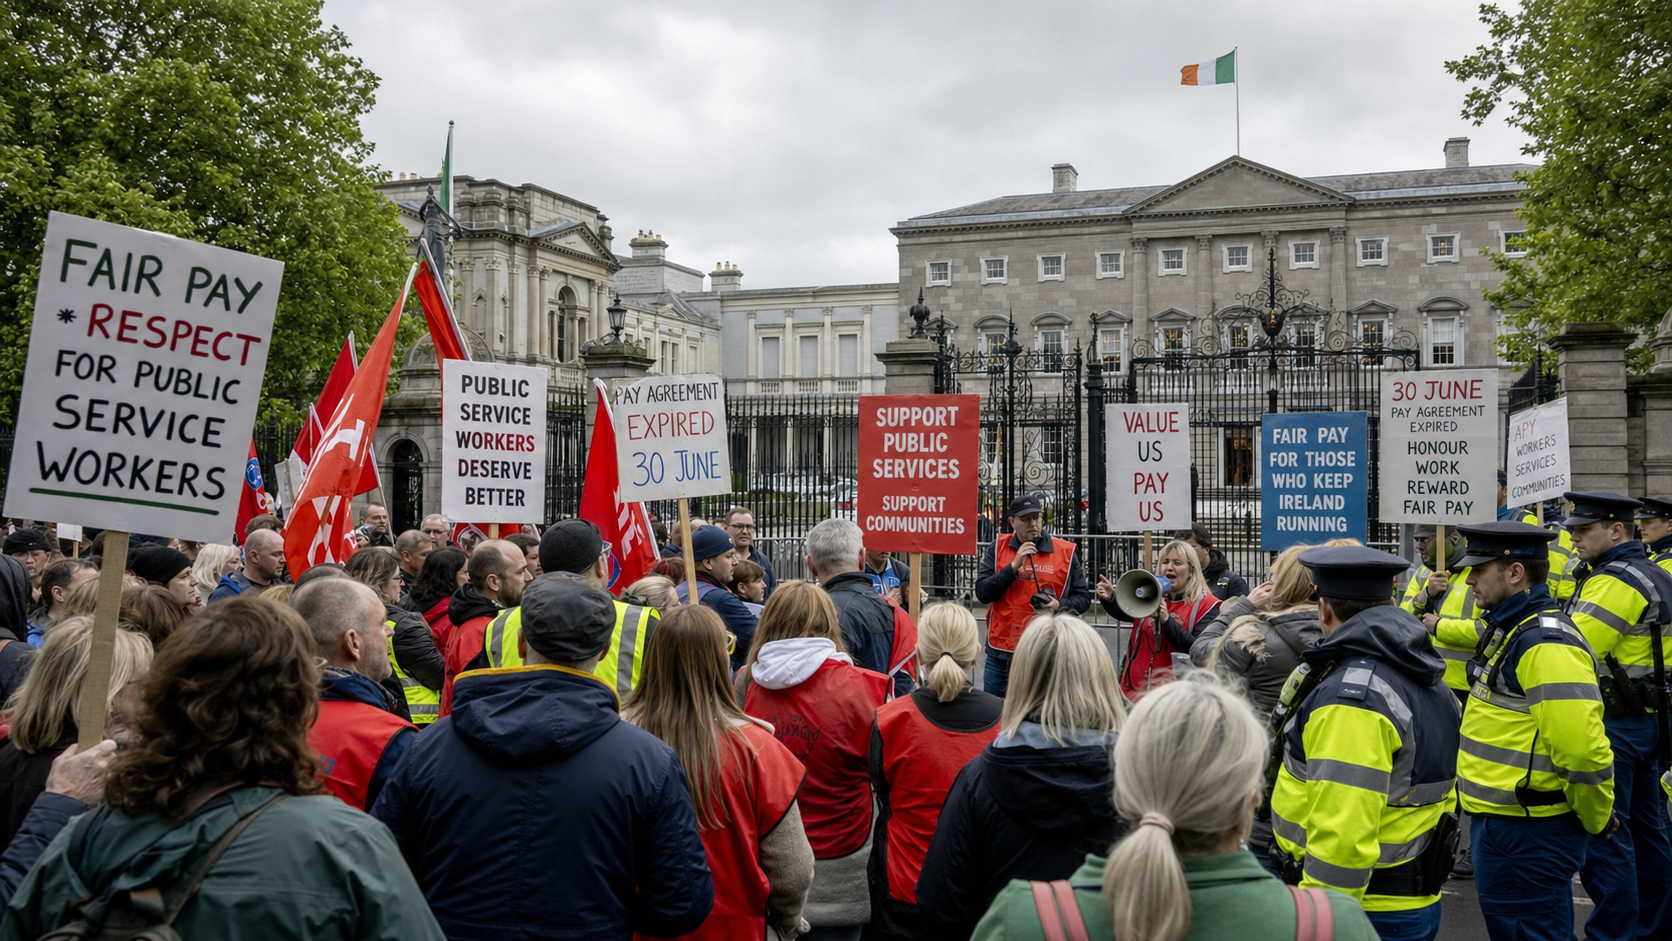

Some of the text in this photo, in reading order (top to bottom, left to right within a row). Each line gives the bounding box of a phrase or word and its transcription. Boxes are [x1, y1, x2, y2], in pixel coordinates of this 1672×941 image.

[60, 239, 263, 314] FAIR PAY
[87, 303, 262, 366] RESPECT
[55, 350, 240, 404] FOR PUBLIC
[462, 375, 529, 398] PUBLIC
[616, 382, 719, 405] PAY AGREEMENT
[1392, 380, 1483, 401] 30 JUNE
[53, 394, 226, 448] SERVICE
[460, 403, 531, 425] SERVICE
[876, 406, 958, 427] SUPPORT
[1391, 405, 1485, 418] PAY AGREEMENT
[628, 411, 714, 440] EXPIRED
[1123, 412, 1179, 433] VALUE
[1410, 421, 1457, 433] EXPIRED
[456, 431, 535, 452] WORKERS
[883, 432, 948, 453] PUBLIC
[1273, 427, 1349, 444] FAIR PAY
[1516, 434, 1556, 457] WORKERS
[1138, 441, 1162, 462] US
[1408, 441, 1468, 455] HONOUR
[458, 459, 531, 479] DESERVE
[633, 450, 721, 486] 30 JUNE
[873, 459, 960, 479] SERVICES
[1270, 451, 1356, 467] FOR THOSE
[1416, 461, 1460, 475] WORK
[1515, 454, 1556, 477] SERVICES
[37, 440, 226, 500] WORKERS
[1272, 473, 1353, 488] WHO KEEP
[1134, 472, 1169, 494] PAY
[1408, 480, 1469, 494] REWARD
[1512, 474, 1565, 499] COMMUNITIES
[465, 487, 525, 506] BETTER
[882, 496, 946, 512] SUPPORT
[1280, 495, 1345, 510] IRELAND
[1140, 501, 1163, 522] US
[1404, 500, 1473, 515] FAIR PAY
[866, 516, 964, 534] COMMUNITIES
[1277, 516, 1347, 532] RUNNING
